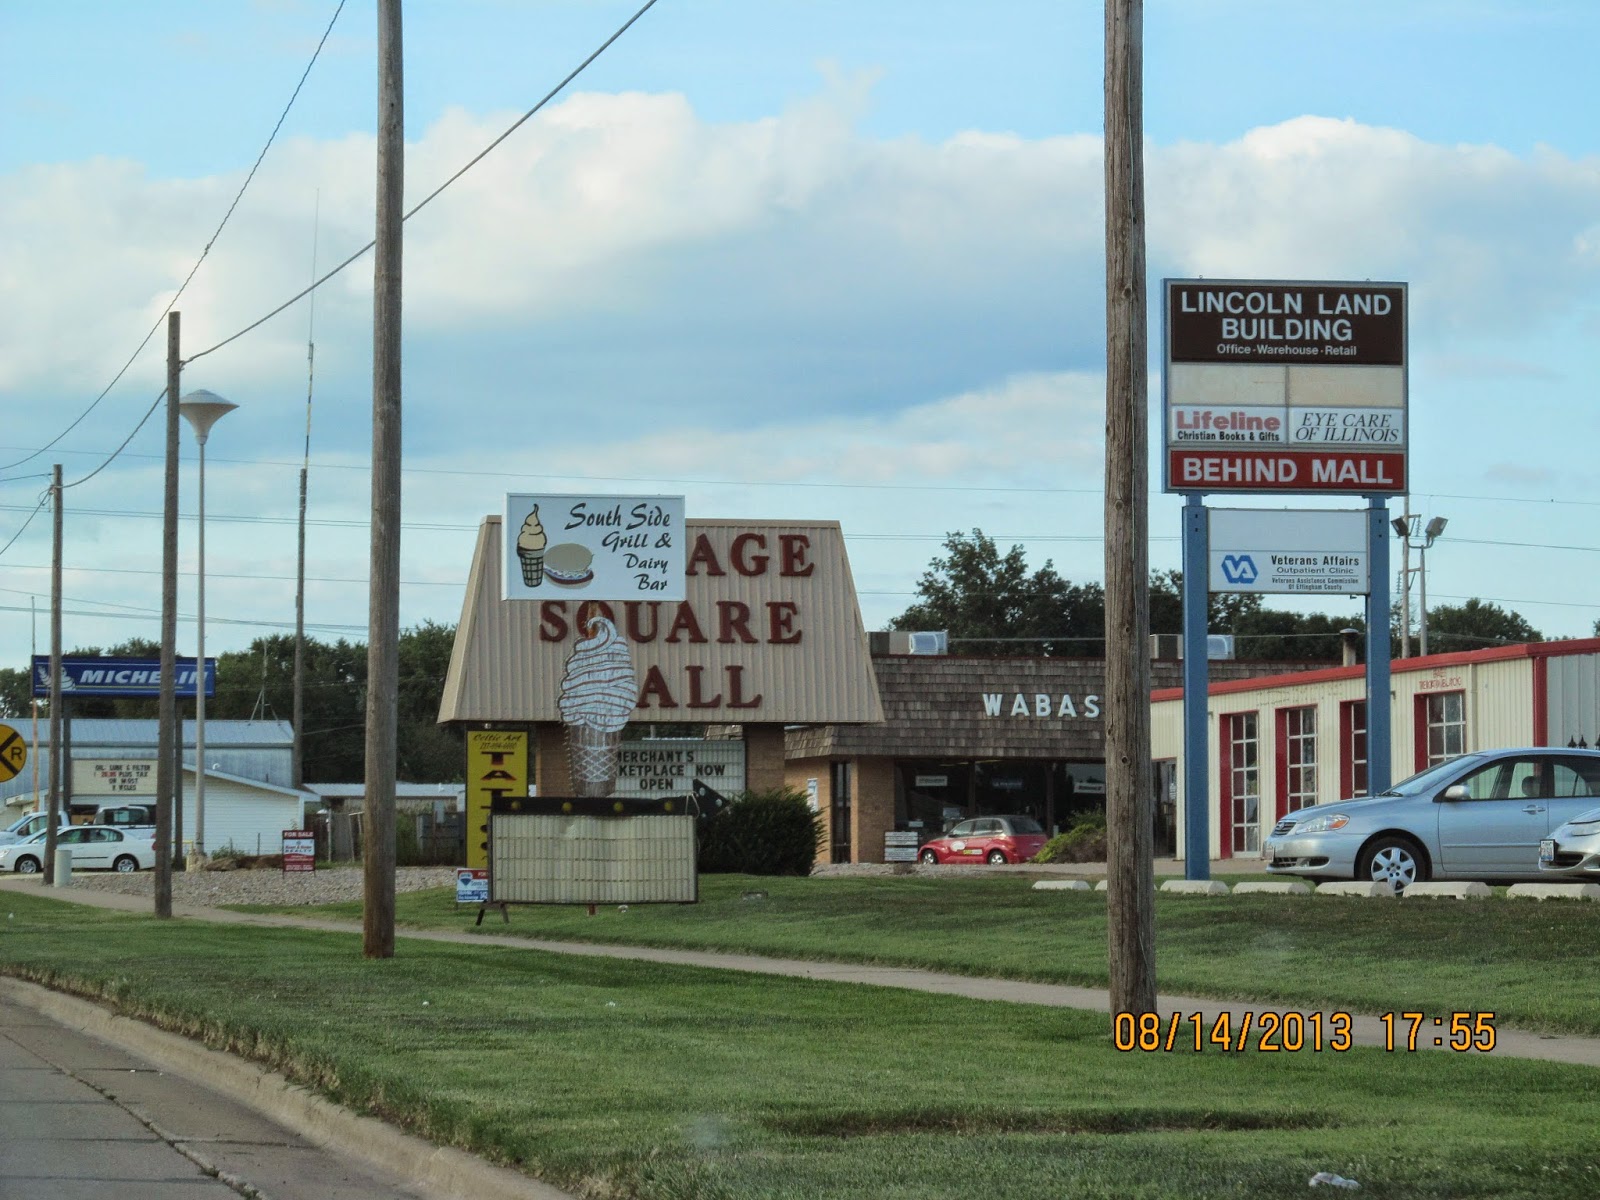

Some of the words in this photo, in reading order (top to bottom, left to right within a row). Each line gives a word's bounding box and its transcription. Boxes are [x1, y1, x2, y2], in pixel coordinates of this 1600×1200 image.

[1181, 291, 1303, 315] LINCOLN
[1318, 293, 1392, 316] LAND
[1221, 318, 1353, 341] BUILDING
[1176, 410, 1281, 431] Lifeline
[1302, 412, 1338, 427] EYE
[1342, 413, 1392, 428] CARE
[1177, 431, 1216, 441] Christian
[1219, 431, 1246, 441] Books
[1249, 432, 1255, 441] &
[1259, 432, 1280, 442] Gifts
[1296, 427, 1320, 441] OF
[1323, 428, 1399, 442] ILLINOIS
[1183, 457, 1298, 482] BEHIND
[1311, 459, 1394, 484] MALL
[564, 503, 622, 530] South
[625, 503, 671, 530] Side
[602, 531, 648, 552] Grill
[654, 532, 672, 548] &
[622, 553, 669, 572] Dairy
[1271, 555, 1318, 566] Veterans
[1323, 555, 1360, 566] Affairs
[1276, 567, 1325, 575] Outpatient
[633, 573, 668, 591] Bar
[79, 669, 209, 684] MICHEIN
[636, 664, 763, 708] ALL
[982, 693, 1101, 718] WABAS
[11, 746, 23, 761] R
[619, 764, 684, 777] KETPLACE
[695, 764, 726, 776] NOW
[640, 778, 674, 790] OPEN
